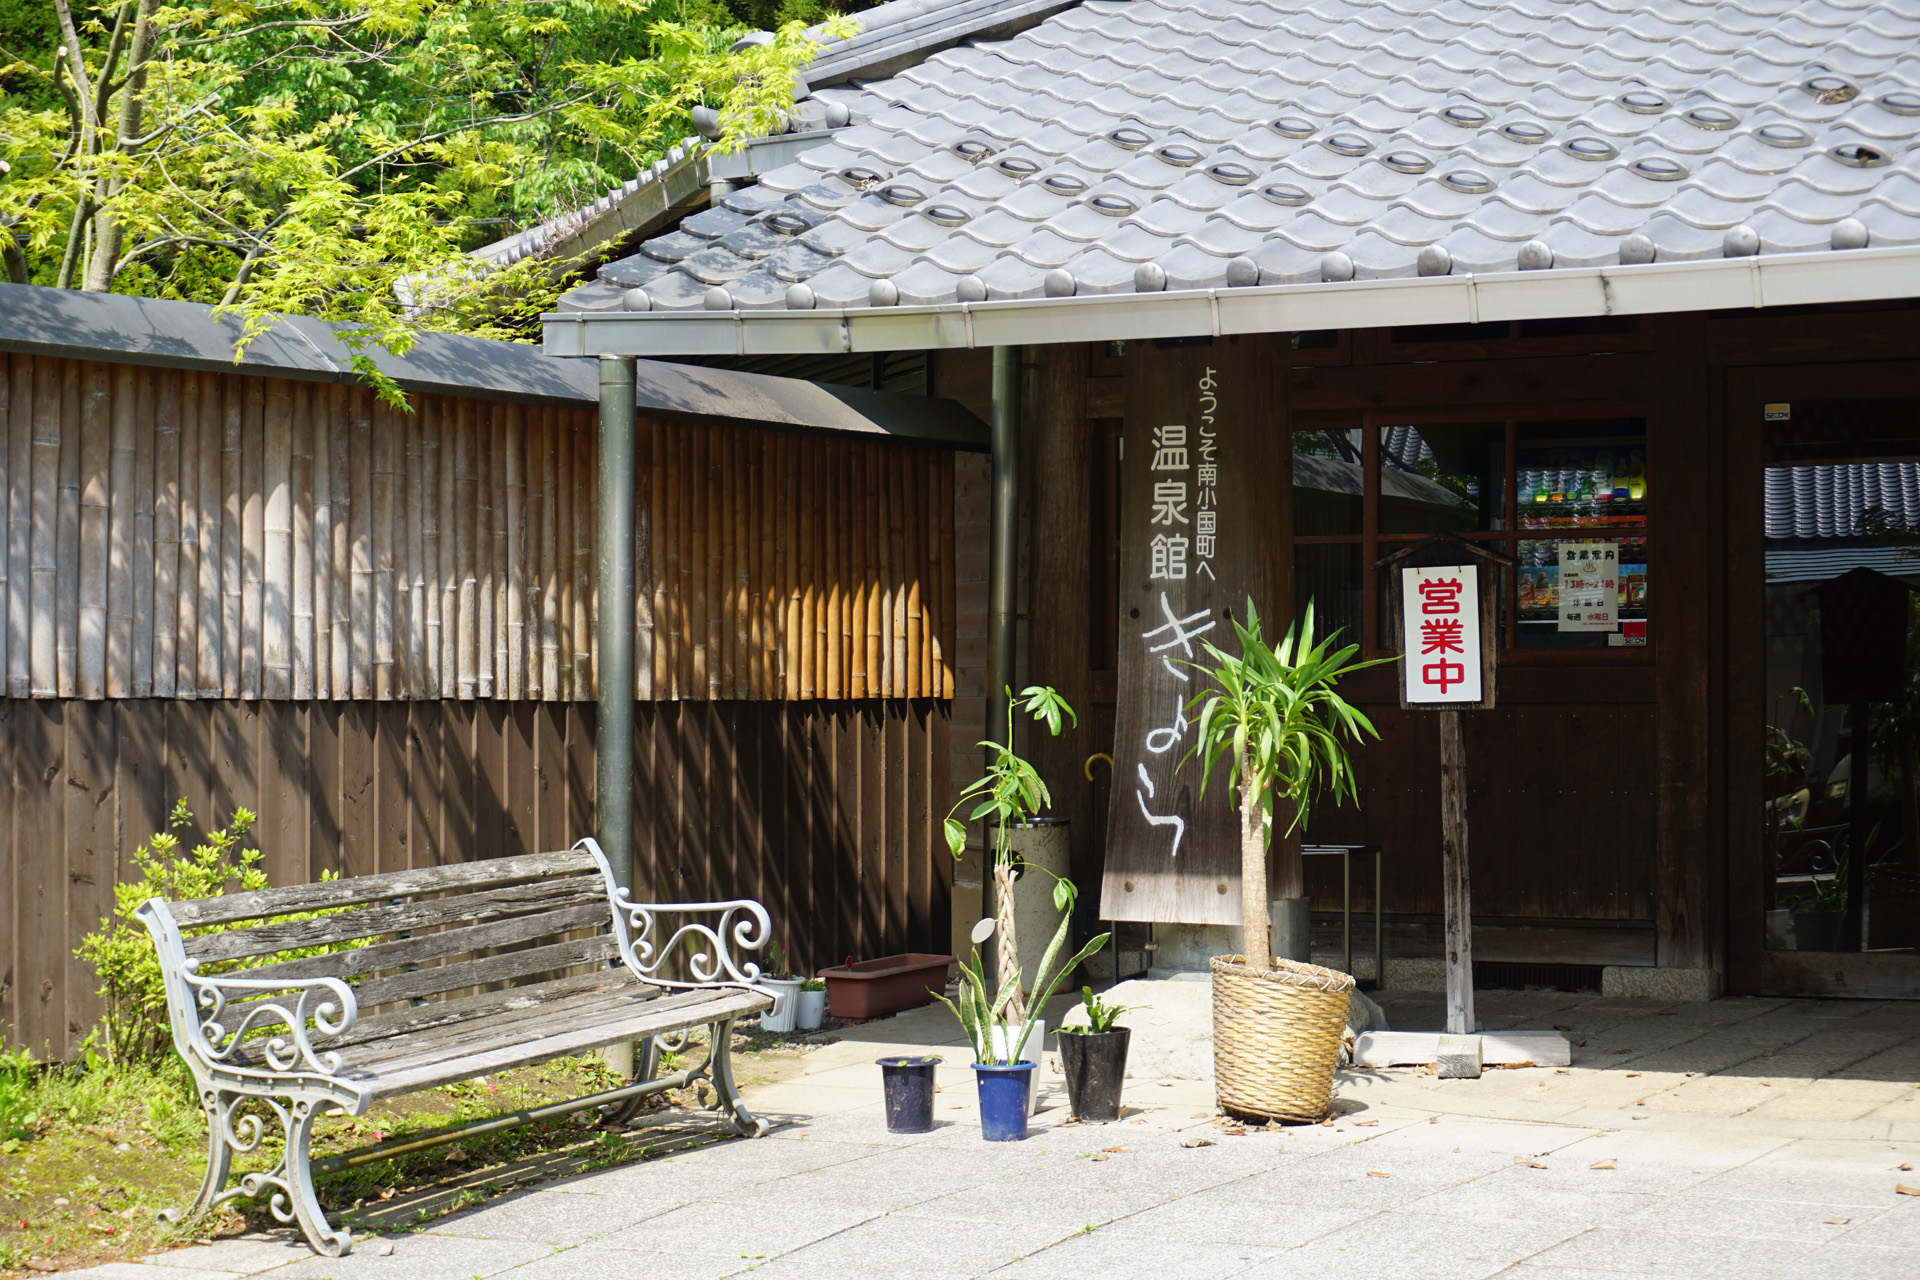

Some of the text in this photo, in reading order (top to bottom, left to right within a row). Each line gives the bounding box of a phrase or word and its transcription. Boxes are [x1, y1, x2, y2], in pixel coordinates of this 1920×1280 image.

[1196, 366, 1218, 581] ようこそ南小国町へ
[1766, 411, 1789, 419] SECOM
[1150, 425, 1190, 580] 温泉館
[1566, 550, 1615, 560] 営業案内
[1418, 577, 1465, 695] 営業中
